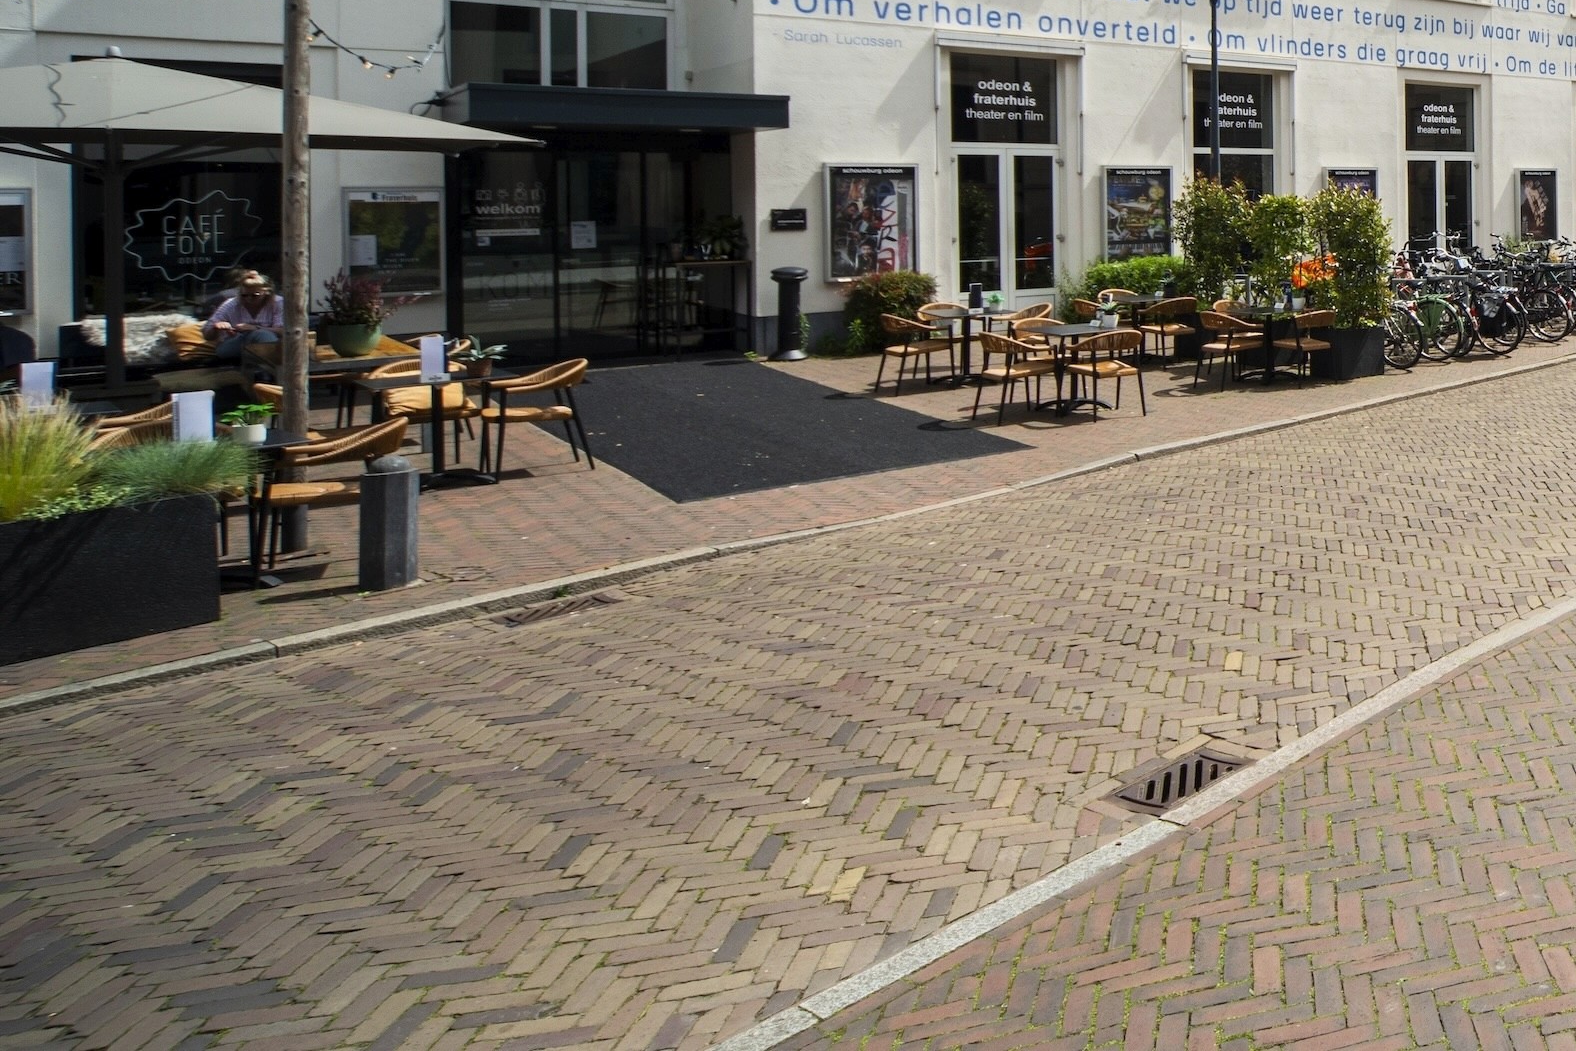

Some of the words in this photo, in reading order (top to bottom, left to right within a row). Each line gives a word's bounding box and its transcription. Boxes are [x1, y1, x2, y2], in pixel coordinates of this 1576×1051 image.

[1293, 4, 1343, 22] weer
[1354, 7, 1405, 33] terug
[1414, 17, 1444, 35] zijn
[1454, 18, 1473, 39] bij
[1482, 25, 1520, 40] waar
[1529, 30, 1549, 47] wij
[784, 28, 828, 44] Sarah
[836, 34, 902, 48] Lucassen
[874, 0, 1021, 29] verhalen
[1037, 15, 1175, 47] onverteld
[1208, 29, 1245, 50] Om
[1258, 35, 1347, 60] vlinders
[1357, 43, 1386, 62] die
[1396, 49, 1449, 69] graag
[1458, 53, 1487, 72] vrij
[1506, 56, 1531, 72] Om
[1539, 60, 1556, 75] de
[978, 79, 1020, 91] odeon
[1022, 81, 1032, 92] &
[973, 93, 1036, 107] fraterhuis
[1246, 94, 1254, 104] &
[965, 108, 1006, 120] theater
[1008, 111, 1022, 120] en
[1024, 110, 1044, 121] film
[1209, 106, 1257, 116] aterhuis
[1423, 104, 1447, 112] odeon
[1448, 104, 1455, 113] &
[1203, 117, 1234, 128] thater
[1235, 121, 1247, 129] en
[1247, 119, 1263, 129] film
[1421, 114, 1457, 124] fraterhuis
[1416, 125, 1440, 134] theater
[1449, 126, 1462, 135] film
[475, 203, 541, 215] welkom
[178, 256, 212, 265] ODEON
